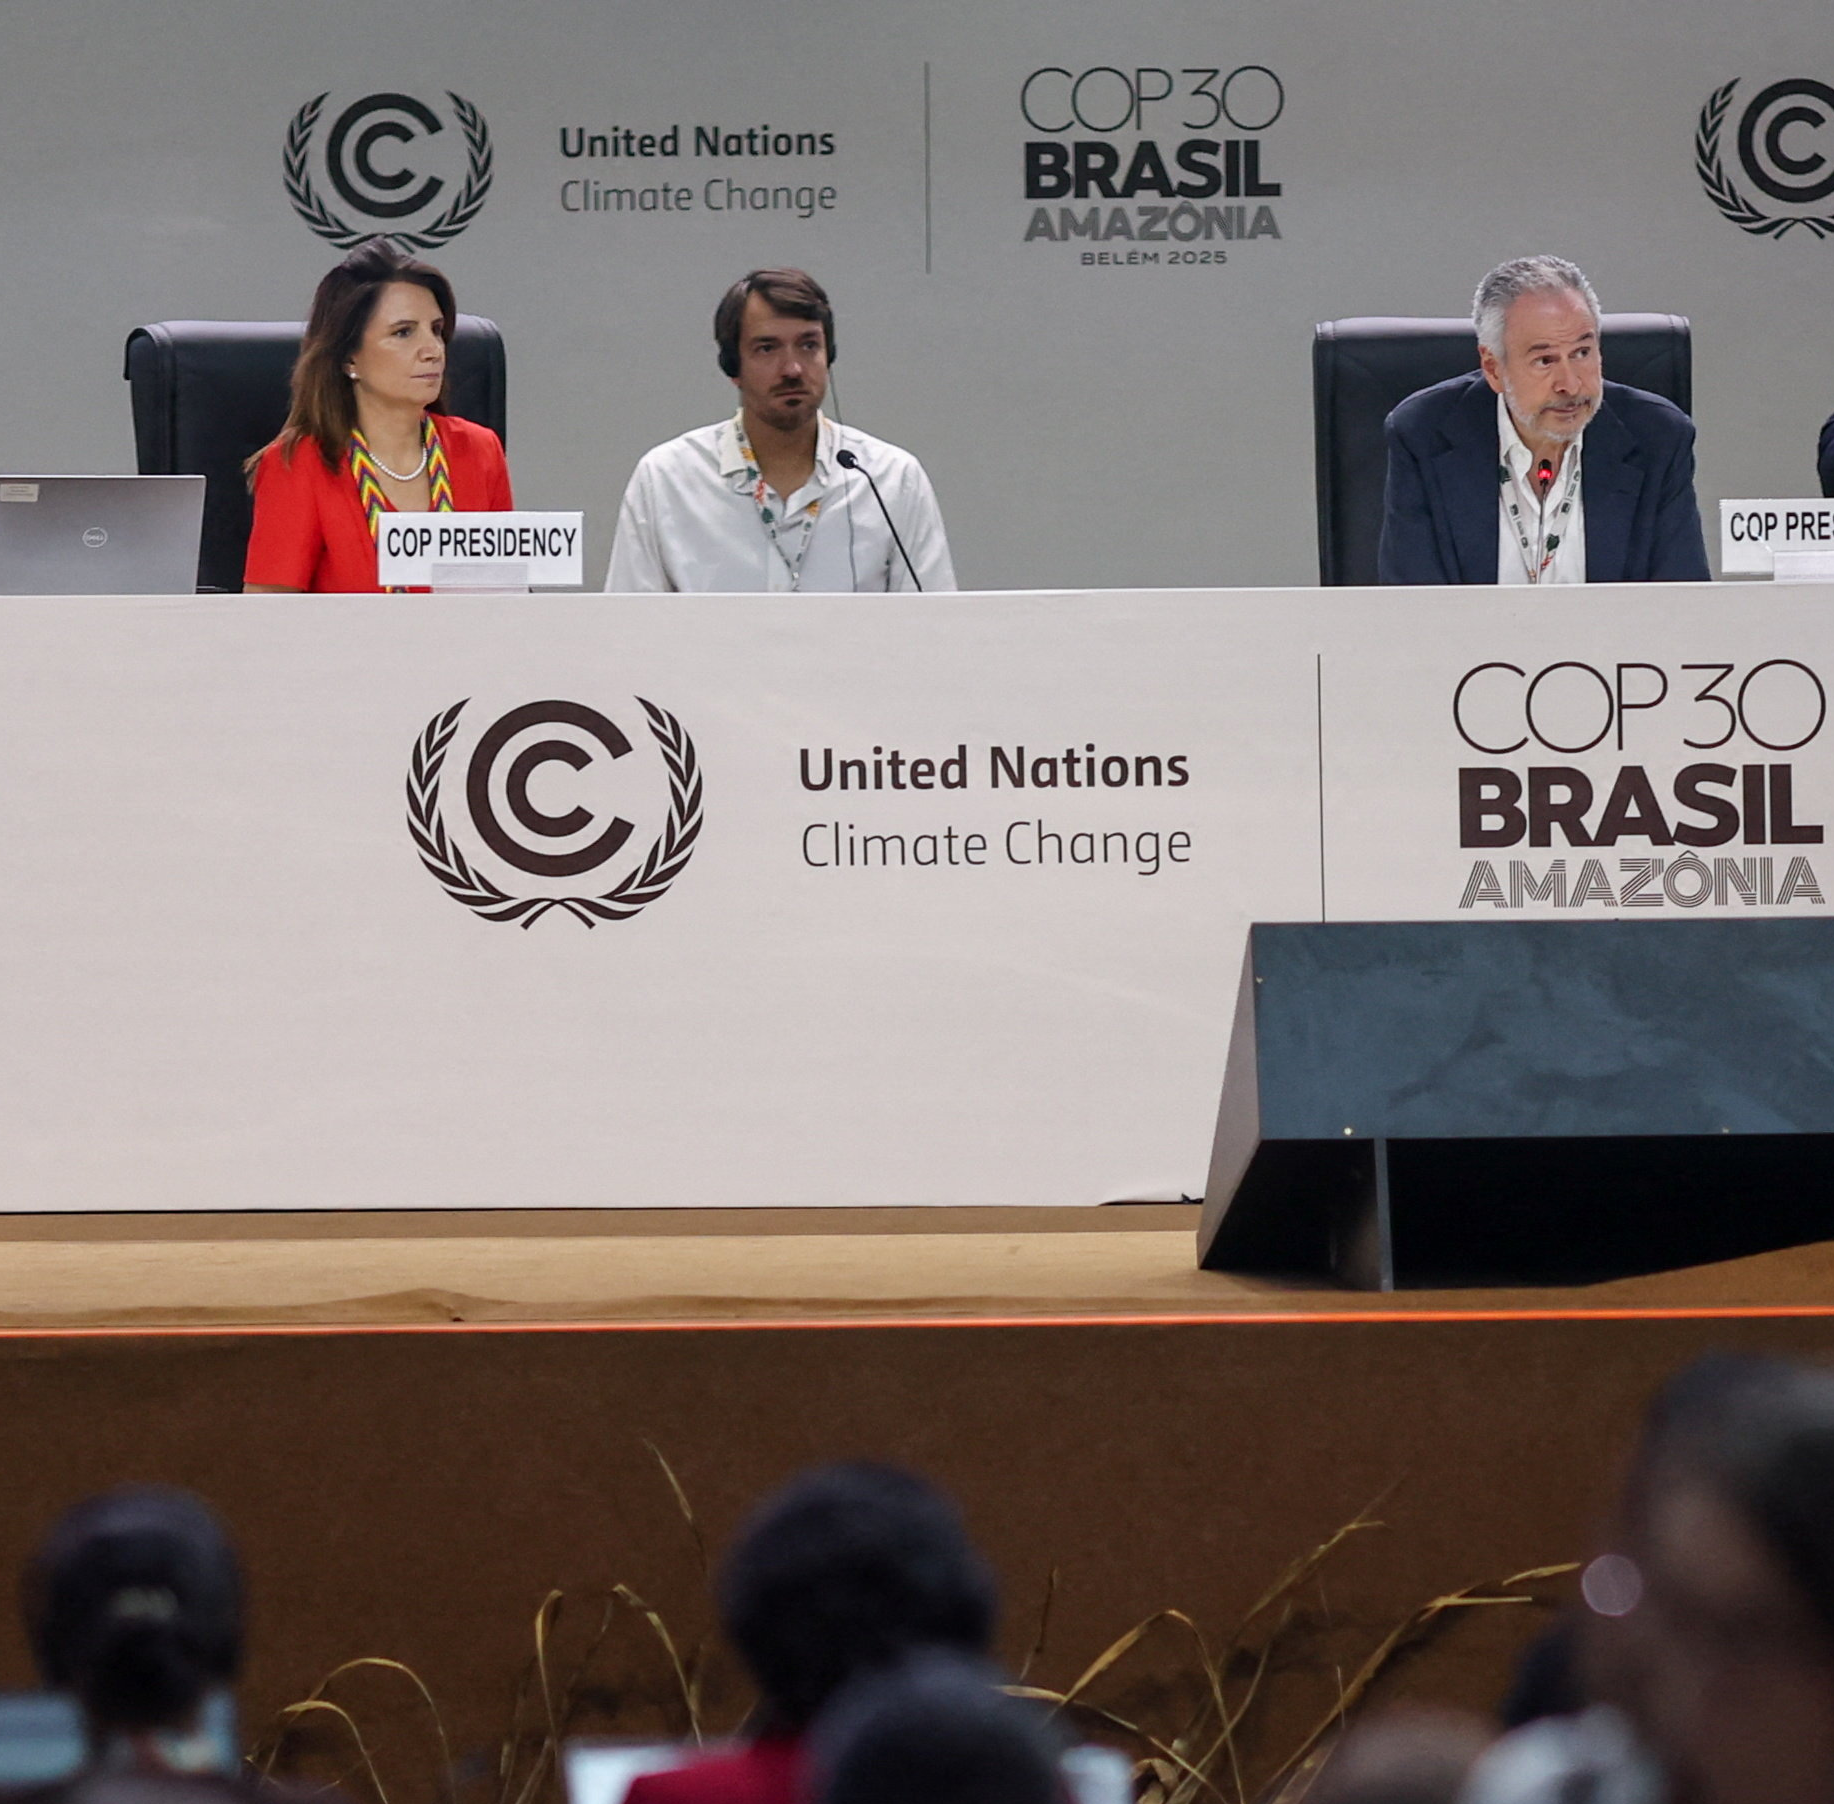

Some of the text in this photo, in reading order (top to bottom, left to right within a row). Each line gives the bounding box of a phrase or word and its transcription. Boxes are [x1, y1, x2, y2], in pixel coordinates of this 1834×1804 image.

[561, 125, 834, 158] United Nations
[1025, 139, 1281, 199] BRASIL
[561, 178, 836, 219] Climate Change
[1024, 200, 1282, 242] AMAZÔNIA
[1081, 251, 1227, 265] BELÉM 2025
[388, 528, 576, 557] COP PRESIDENCY
[1731, 512, 1777, 541] COP
[800, 743, 1189, 791] United Nations
[1459, 763, 1824, 848] BRASIL
[803, 819, 1191, 875] Climate Change
[1459, 850, 1825, 908] AMAZÔNIA
